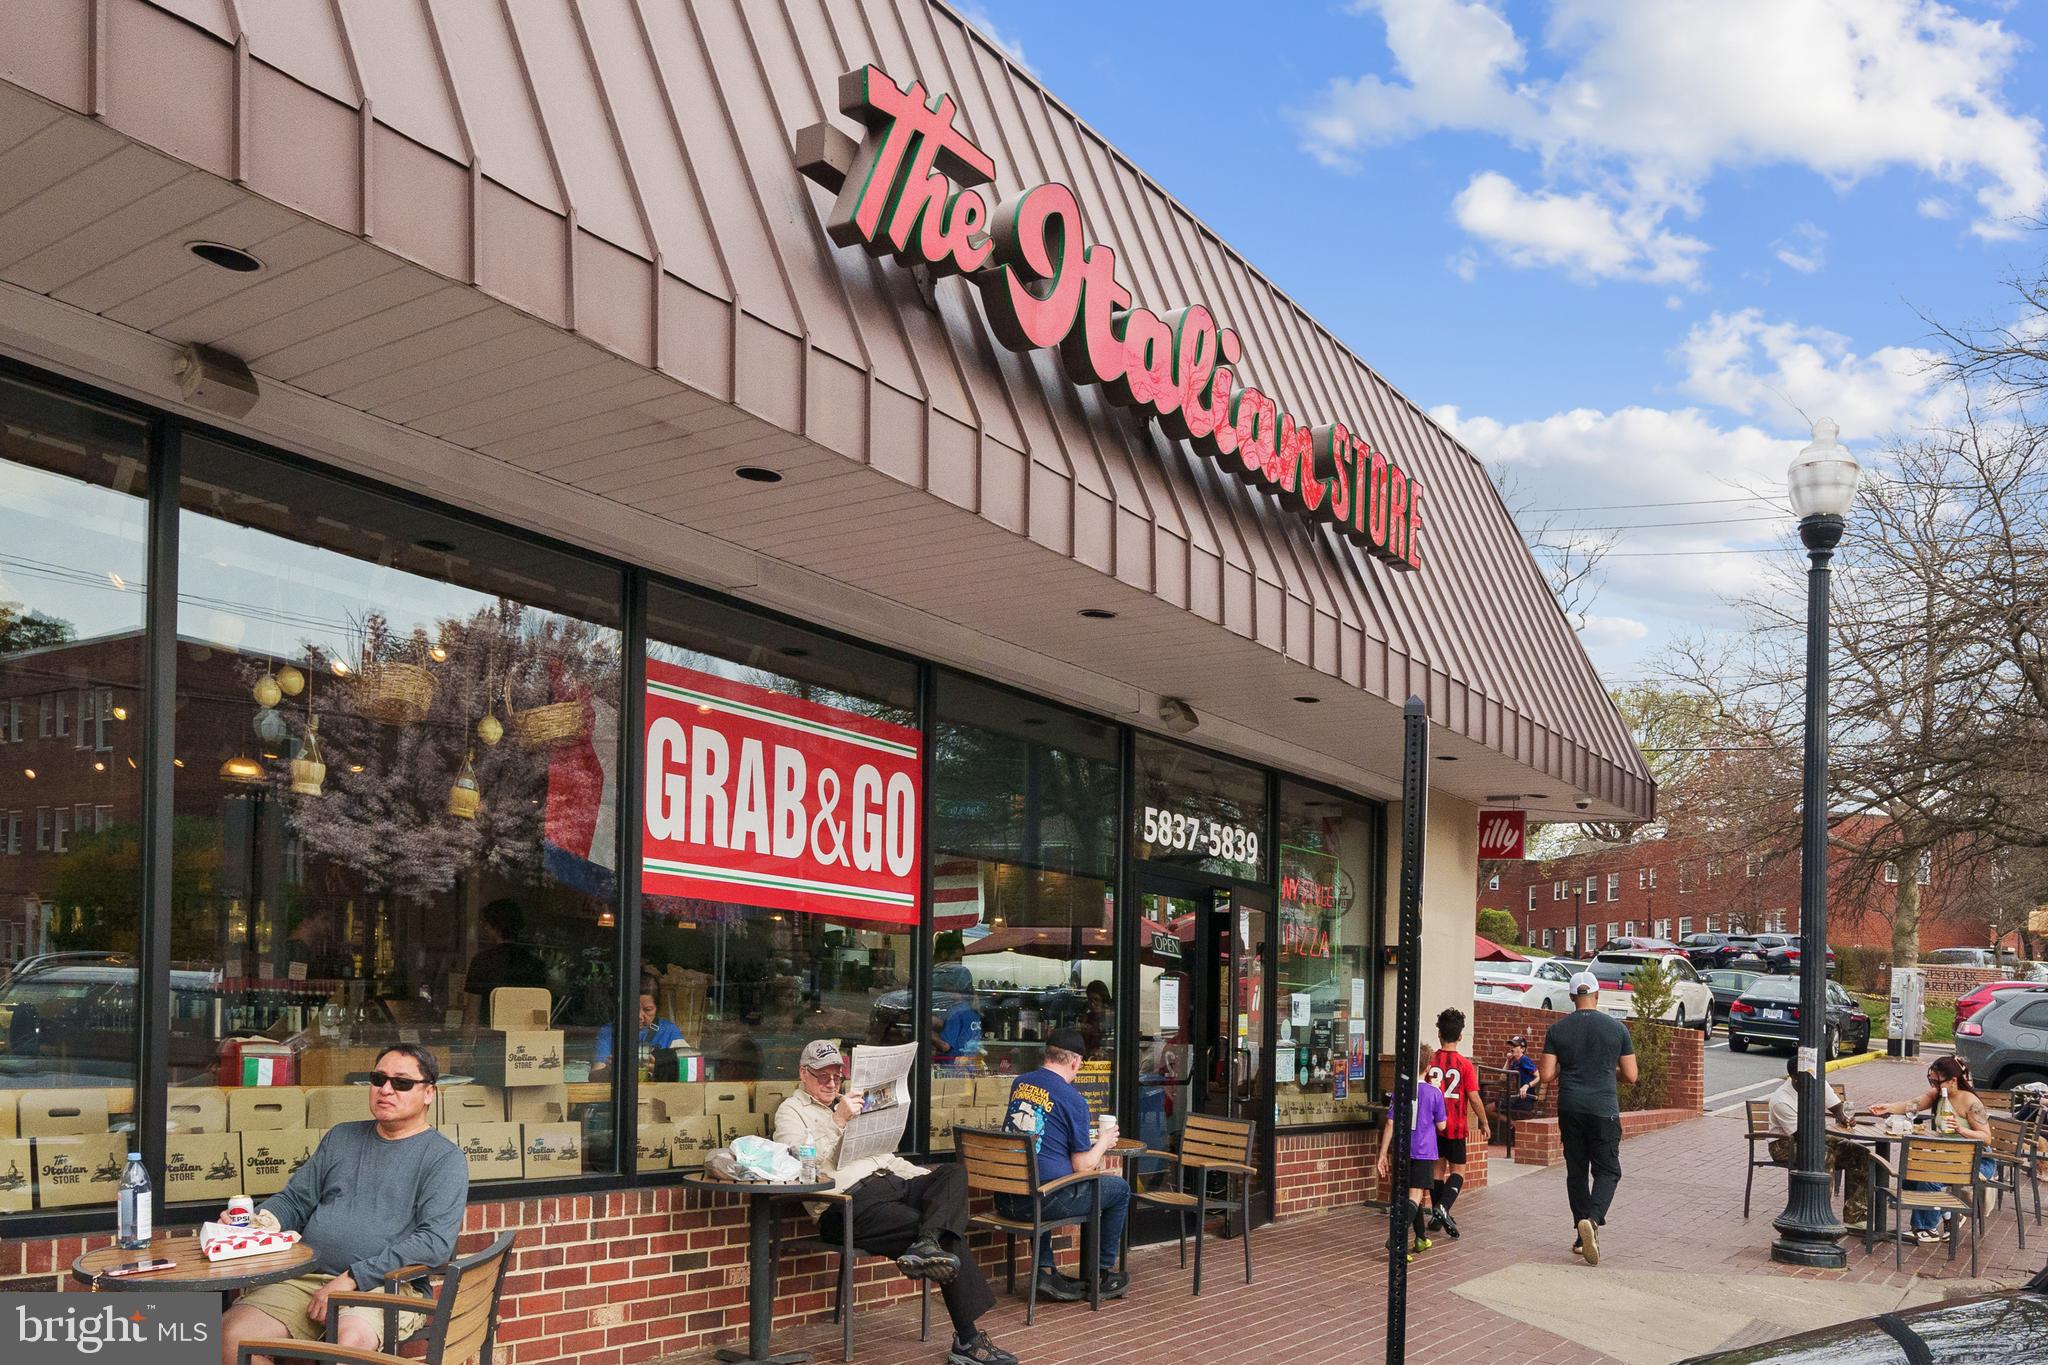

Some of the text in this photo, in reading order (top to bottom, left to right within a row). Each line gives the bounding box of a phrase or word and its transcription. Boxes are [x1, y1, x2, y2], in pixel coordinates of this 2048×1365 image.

[853, 64, 1425, 570] The Italian STORE
[1143, 806, 1259, 864] 5837-5839
[1481, 818, 1520, 855] illy
[1154, 936, 1180, 953] OPEN
[1284, 923, 1330, 959] PIZZA
[1925, 981, 1980, 994] ARTMEN
[1252, 984, 1261, 1011] il
[514, 1061, 533, 1069] STORE
[1017, 1082, 1050, 1100] SULTANA
[257, 1147, 270, 1158] The
[470, 1154, 489, 1162] STORE
[533, 1154, 551, 1162] STORE
[171, 1153, 185, 1164] The
[246, 1158, 286, 1167] Italian
[42, 1165, 88, 1177] Italian
[256, 1166, 279, 1175] STORE
[52, 1174, 80, 1185] STORE
[169, 1172, 195, 1182] STORE
[232, 1215, 249, 1223] EPSI
